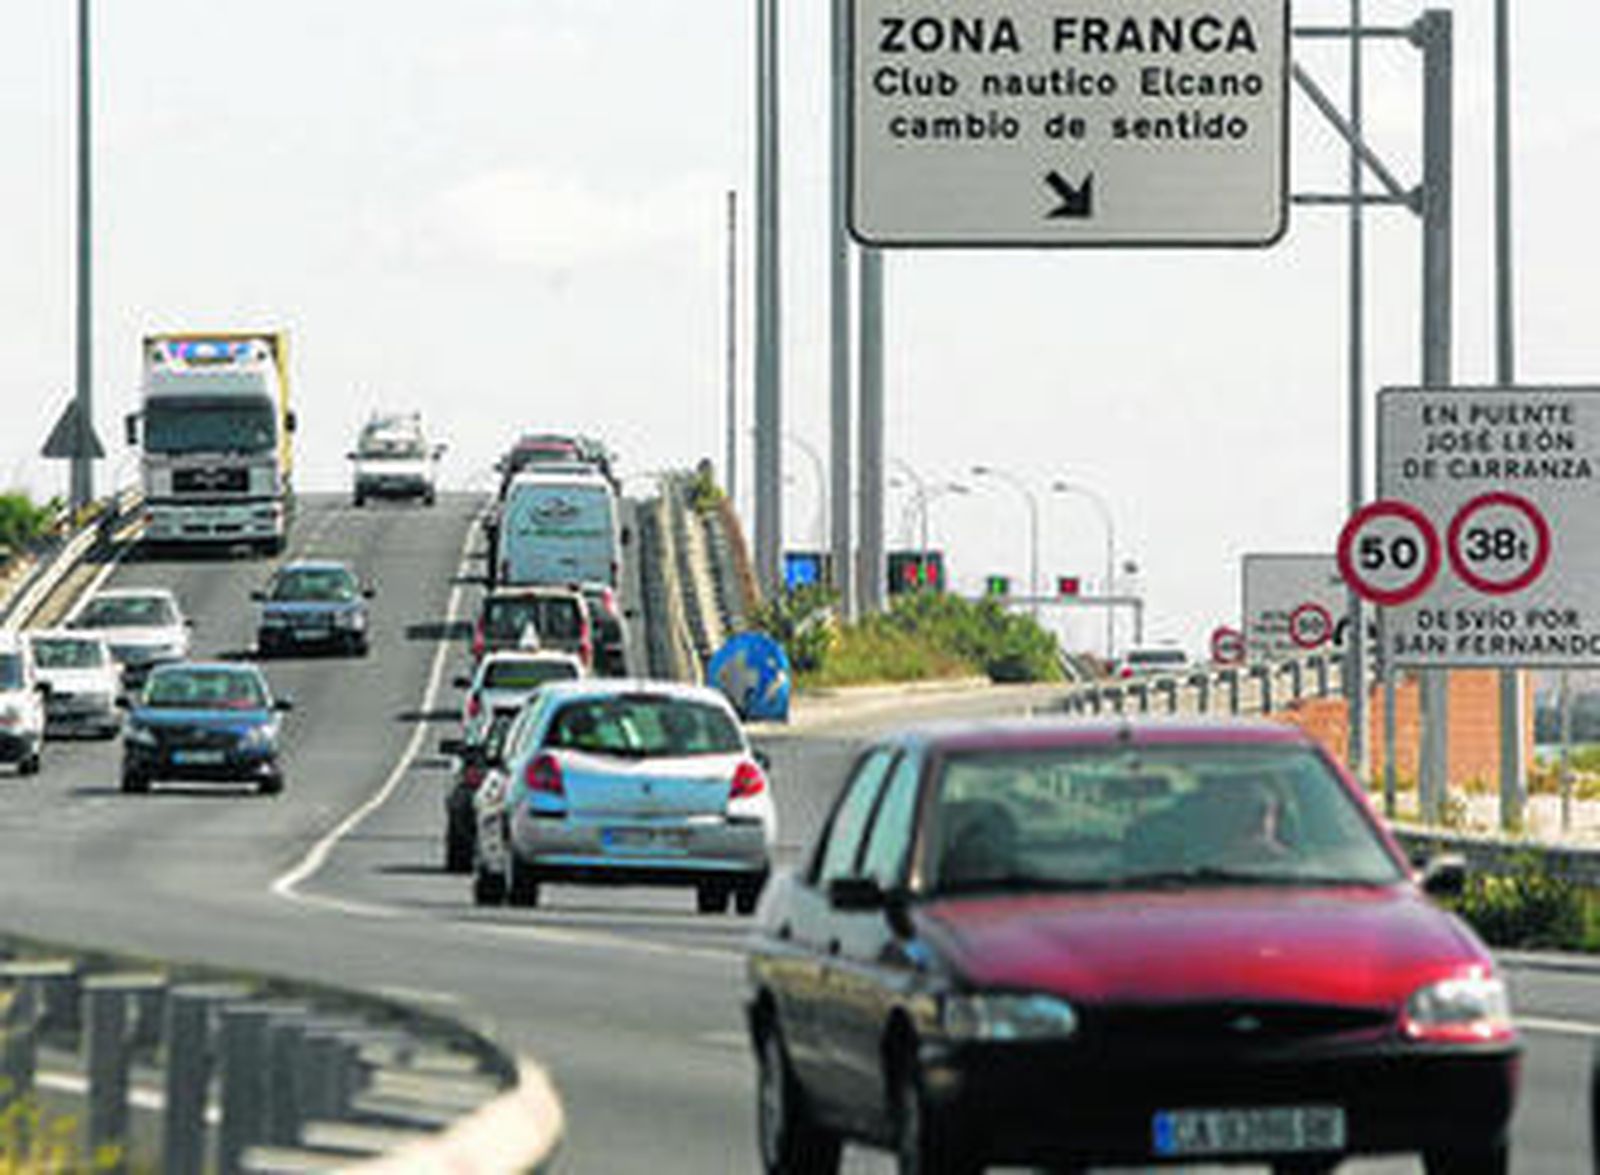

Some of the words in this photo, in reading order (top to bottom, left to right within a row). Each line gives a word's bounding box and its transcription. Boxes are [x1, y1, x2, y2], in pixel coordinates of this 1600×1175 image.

[878, 15, 1022, 54] ZONA
[1052, 13, 1258, 54] FRANCA
[872, 65, 960, 97] Club
[980, 66, 1118, 98] nautico
[1139, 65, 1264, 98] Elcano
[888, 109, 1021, 140] cambio
[1043, 109, 1087, 140] de
[1110, 109, 1249, 140] sentido
[1421, 405, 1459, 425] EN
[1468, 405, 1574, 426] PUENTE
[1425, 429, 1492, 454] JOSÉ
[1502, 430, 1576, 453] LEÓN
[1402, 459, 1437, 479] DE
[1447, 459, 1592, 480] CARRANZA
[1360, 536, 1419, 570] 50
[1466, 528, 1528, 562] 38t
[1525, 610, 1580, 630] POR
[1393, 634, 1447, 655] SAN
